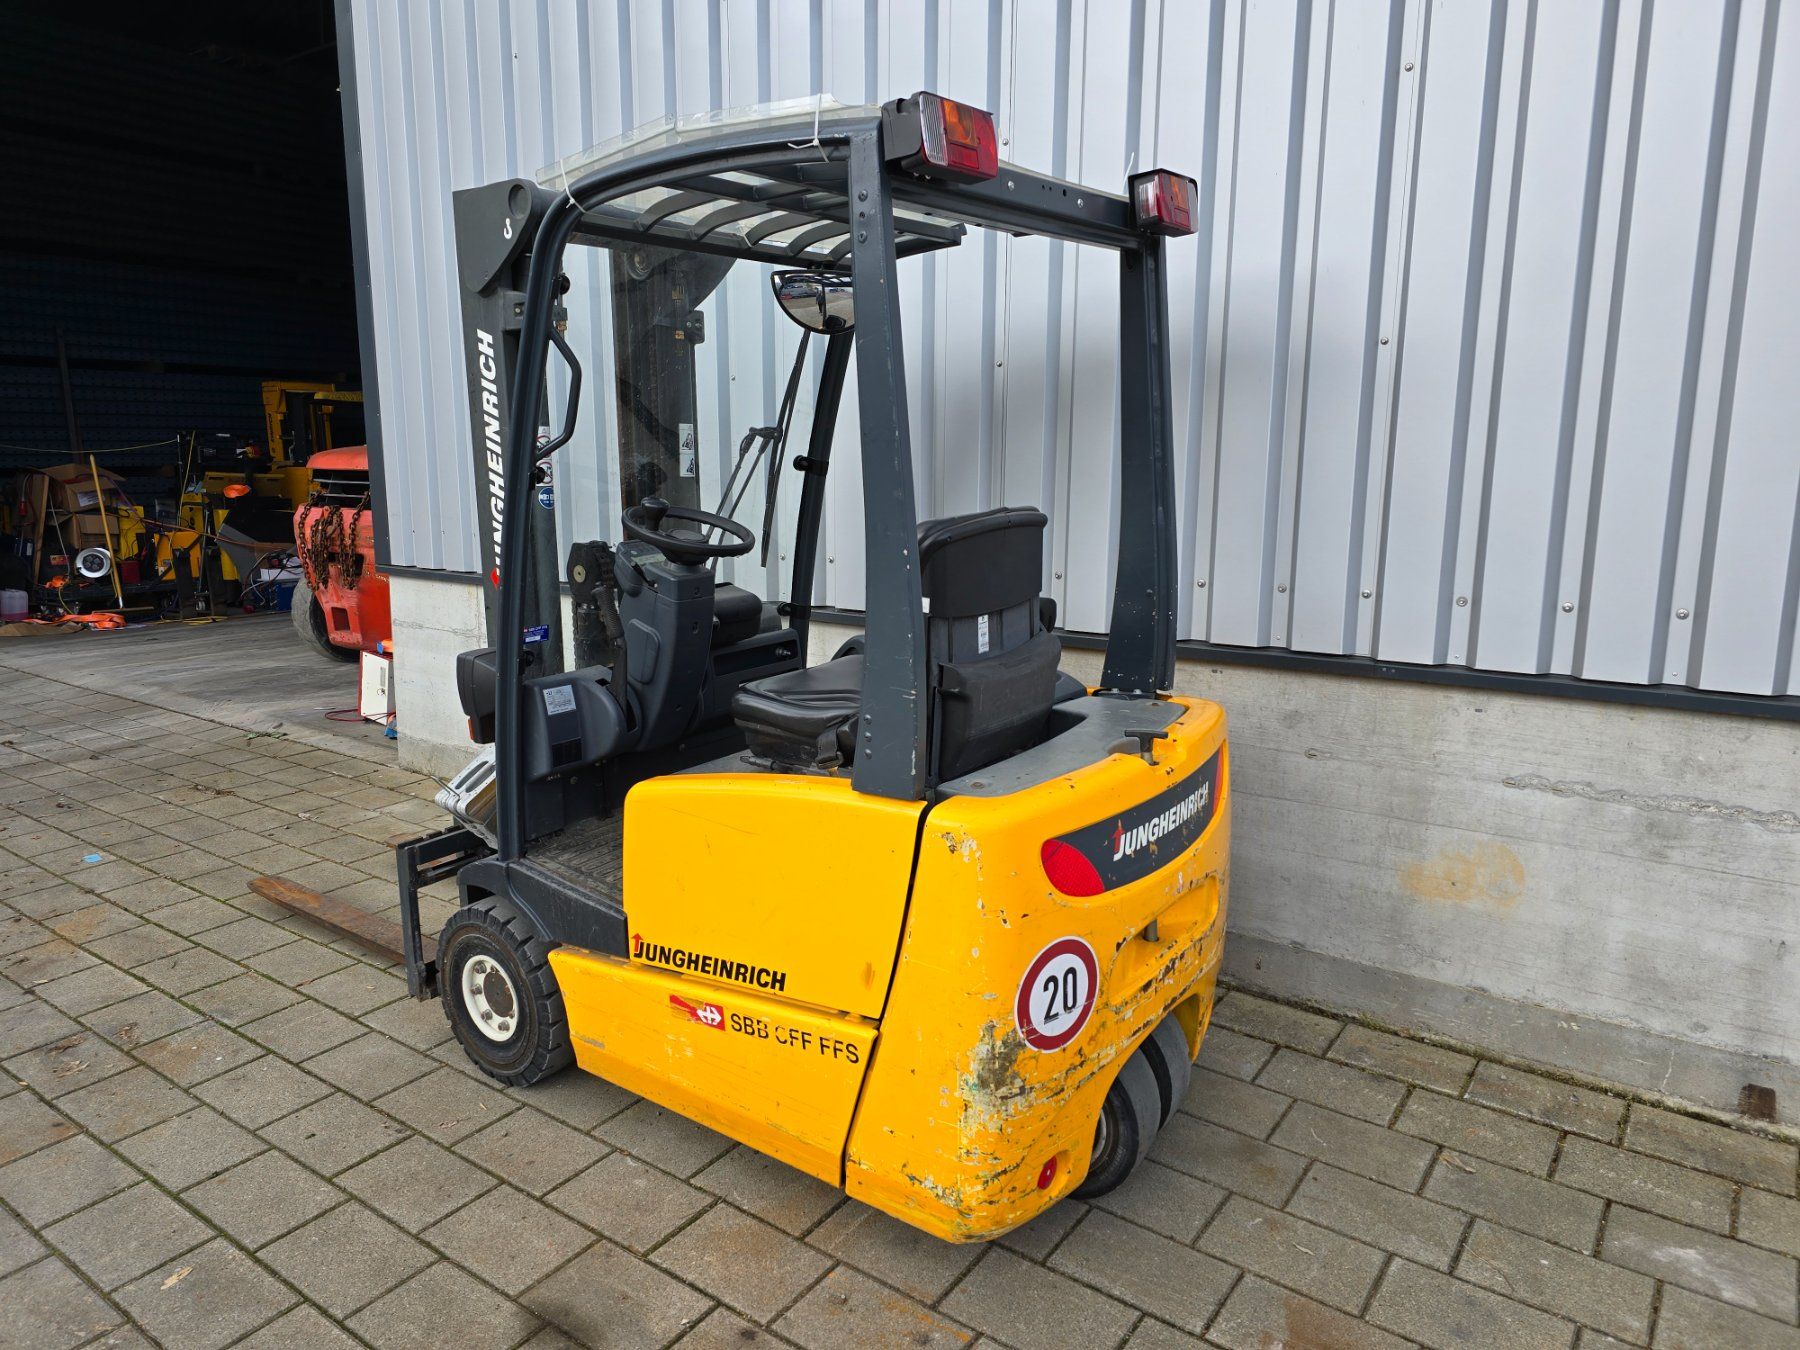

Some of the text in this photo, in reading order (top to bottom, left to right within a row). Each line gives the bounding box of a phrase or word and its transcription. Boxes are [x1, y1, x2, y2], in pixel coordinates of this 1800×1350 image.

[477, 328, 505, 576] NGHEINRICH
[1113, 781, 1209, 861] JUNGHEINRICH
[634, 941, 786, 992] JUNGHEINRICH
[1043, 966, 1078, 1022] 20
[730, 1013, 860, 1064] SBB CFF FFS
